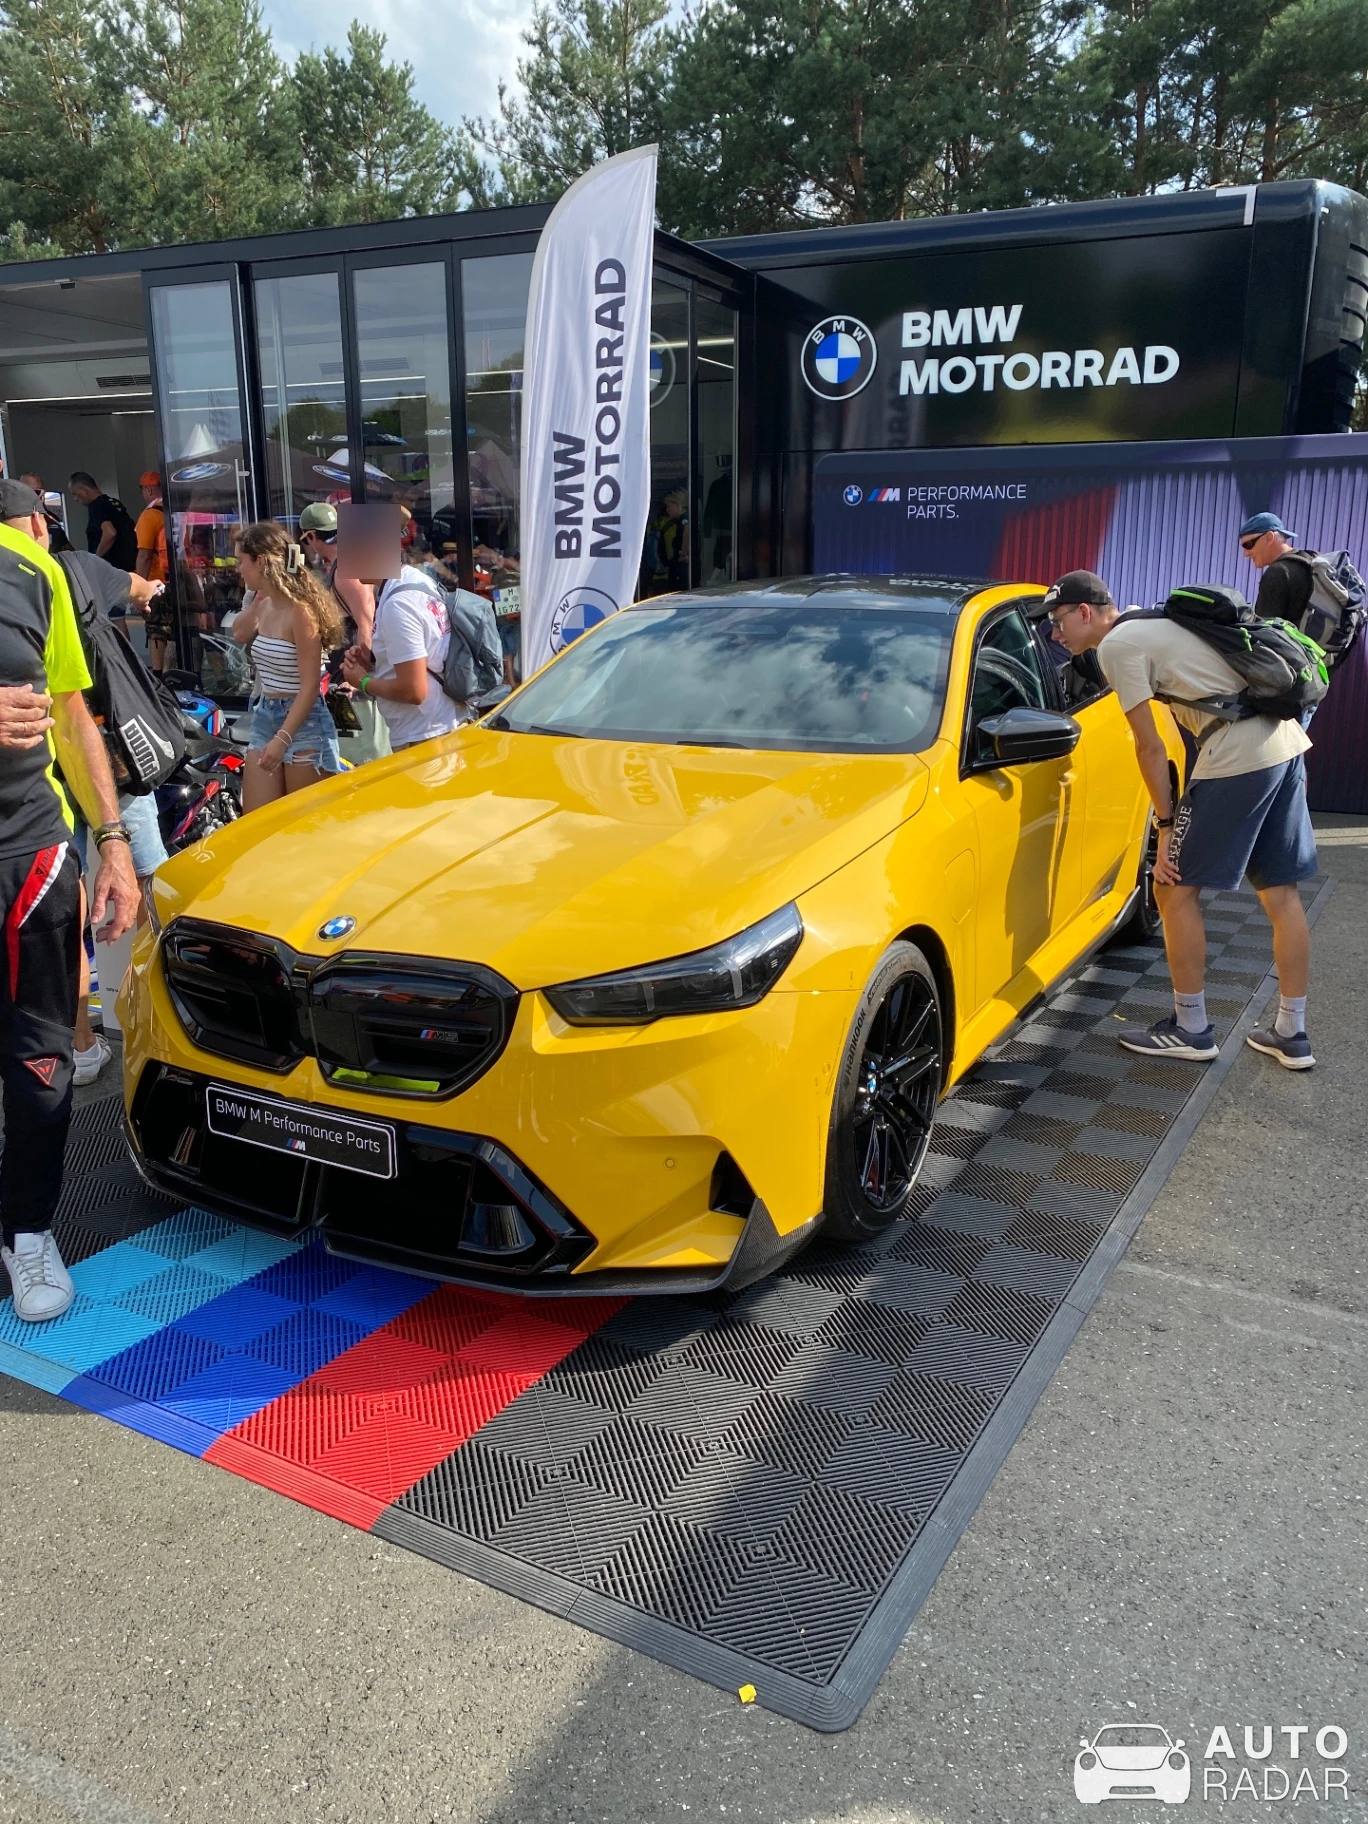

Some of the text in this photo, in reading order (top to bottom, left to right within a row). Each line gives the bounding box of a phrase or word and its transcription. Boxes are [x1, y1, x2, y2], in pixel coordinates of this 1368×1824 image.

[811, 320, 867, 345] BMW
[902, 304, 1023, 348] BMW
[899, 345, 1180, 396] MOTORRAD
[589, 257, 627, 558] MOTORRAD
[553, 430, 586, 559] BMW
[908, 484, 1027, 501] PERFORMANCE
[908, 504, 960, 519] PARTS.
[1168, 805, 1192, 867] RITAGE
[215, 1098, 381, 1153] BMW M Performance Parts
